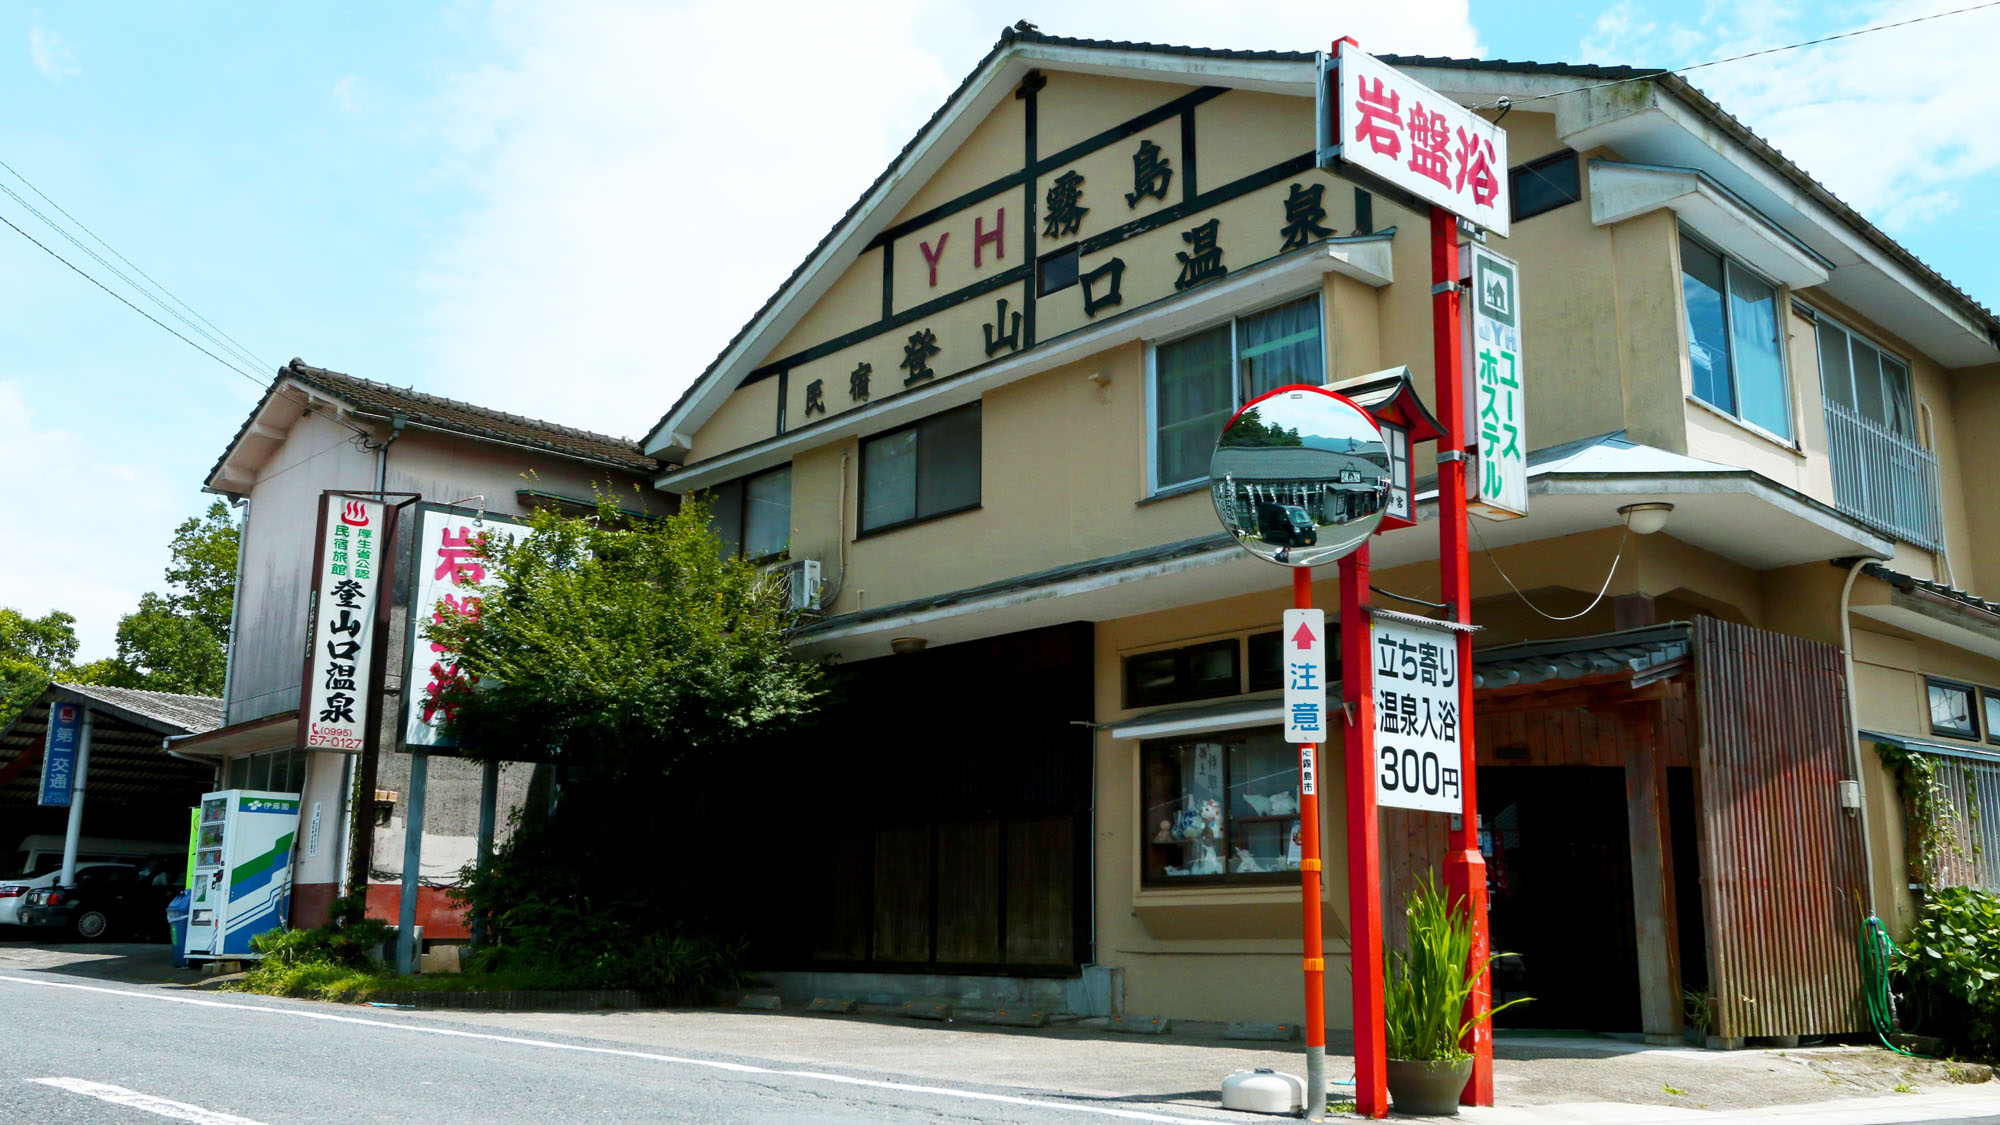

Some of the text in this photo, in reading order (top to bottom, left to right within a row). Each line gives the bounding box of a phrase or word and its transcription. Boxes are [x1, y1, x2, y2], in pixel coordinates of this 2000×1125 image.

[1355, 74, 1499, 209] 岩盤浴
[920, 140, 1173, 286] YH 霧島
[1479, 348, 1503, 499] ホステル
[1500, 351, 1521, 463] ユース
[331, 525, 350, 576] 民宿旅館
[355, 529, 373, 580] 厚生省公認
[320, 579, 366, 723] 登山口温泉
[1378, 633, 1455, 688] 立ち寄り
[1290, 662, 1320, 731] 注意
[1379, 689, 1456, 743] 温泉入浴
[49, 727, 74, 789] 第一交通
[310, 735, 363, 749] 57-0127
[320, 727, 352, 737] (0995)
[1303, 758, 1313, 792] 霧島市
[1380, 746, 1459, 799] 300円
